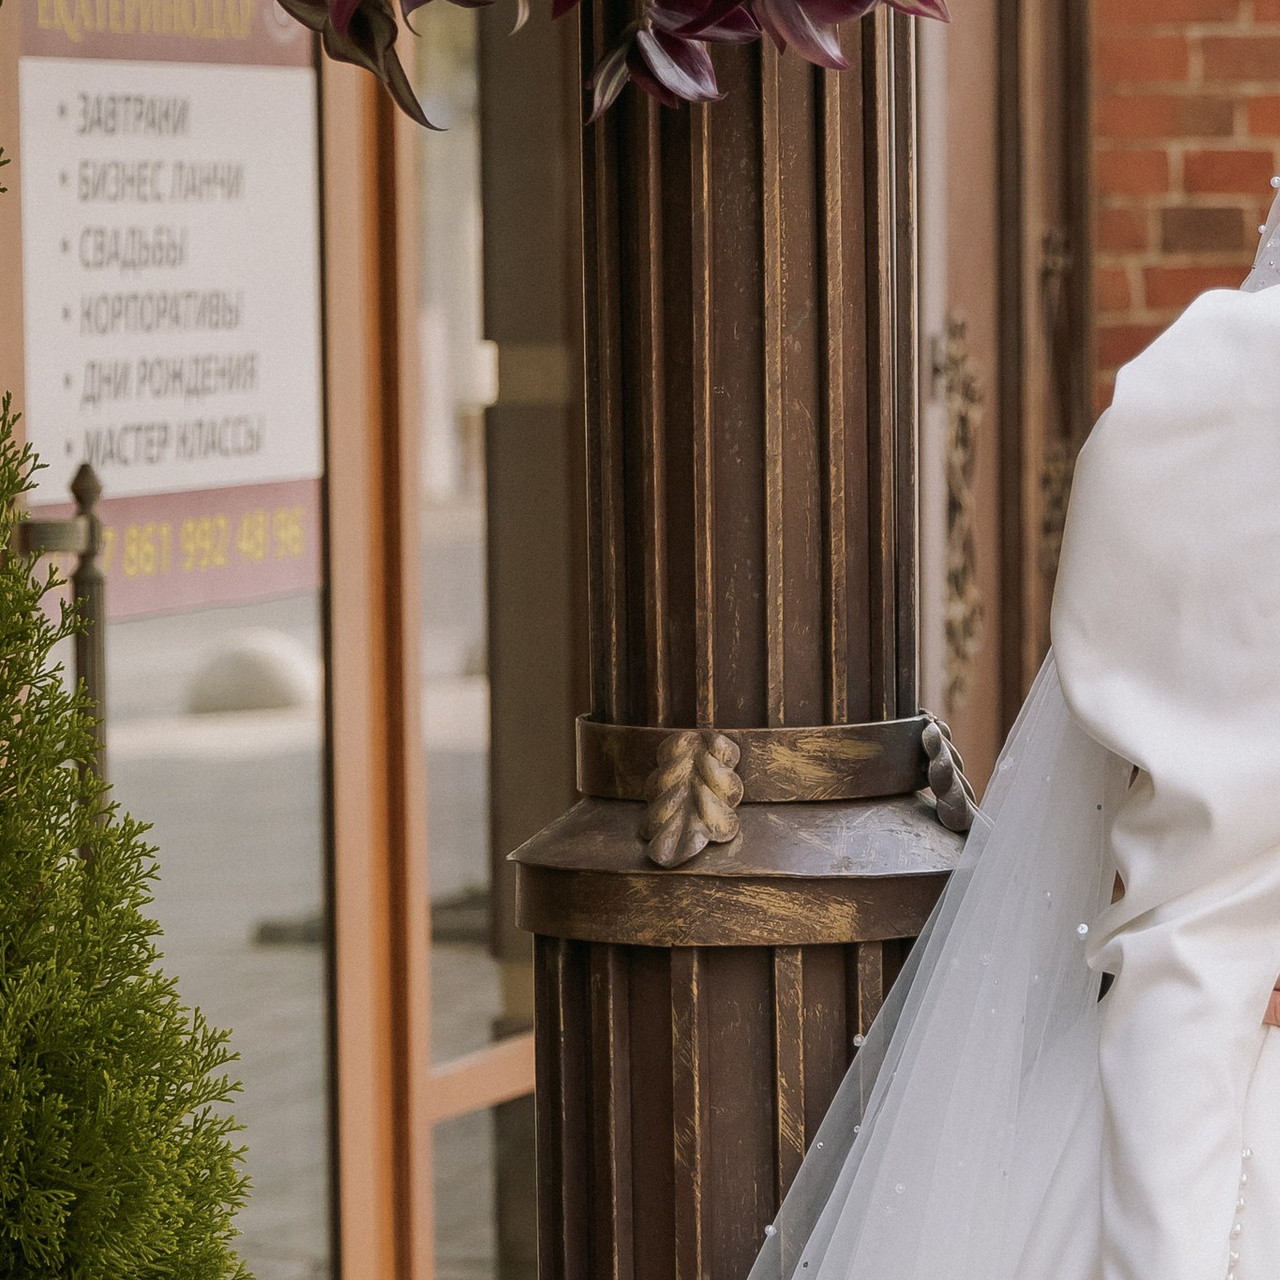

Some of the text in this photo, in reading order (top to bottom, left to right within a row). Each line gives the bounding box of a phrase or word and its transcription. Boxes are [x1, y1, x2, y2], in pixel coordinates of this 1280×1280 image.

[77, 92, 191, 137] ЗАВТРАКИ
[77, 159, 164, 203] БИЗНЕС
[80, 225, 188, 271] СВАДЬБЫ
[80, 289, 243, 337] КОРПОРАТИВЫ
[80, 352, 259, 411] ДНИ РОЖДЕНИЯ
